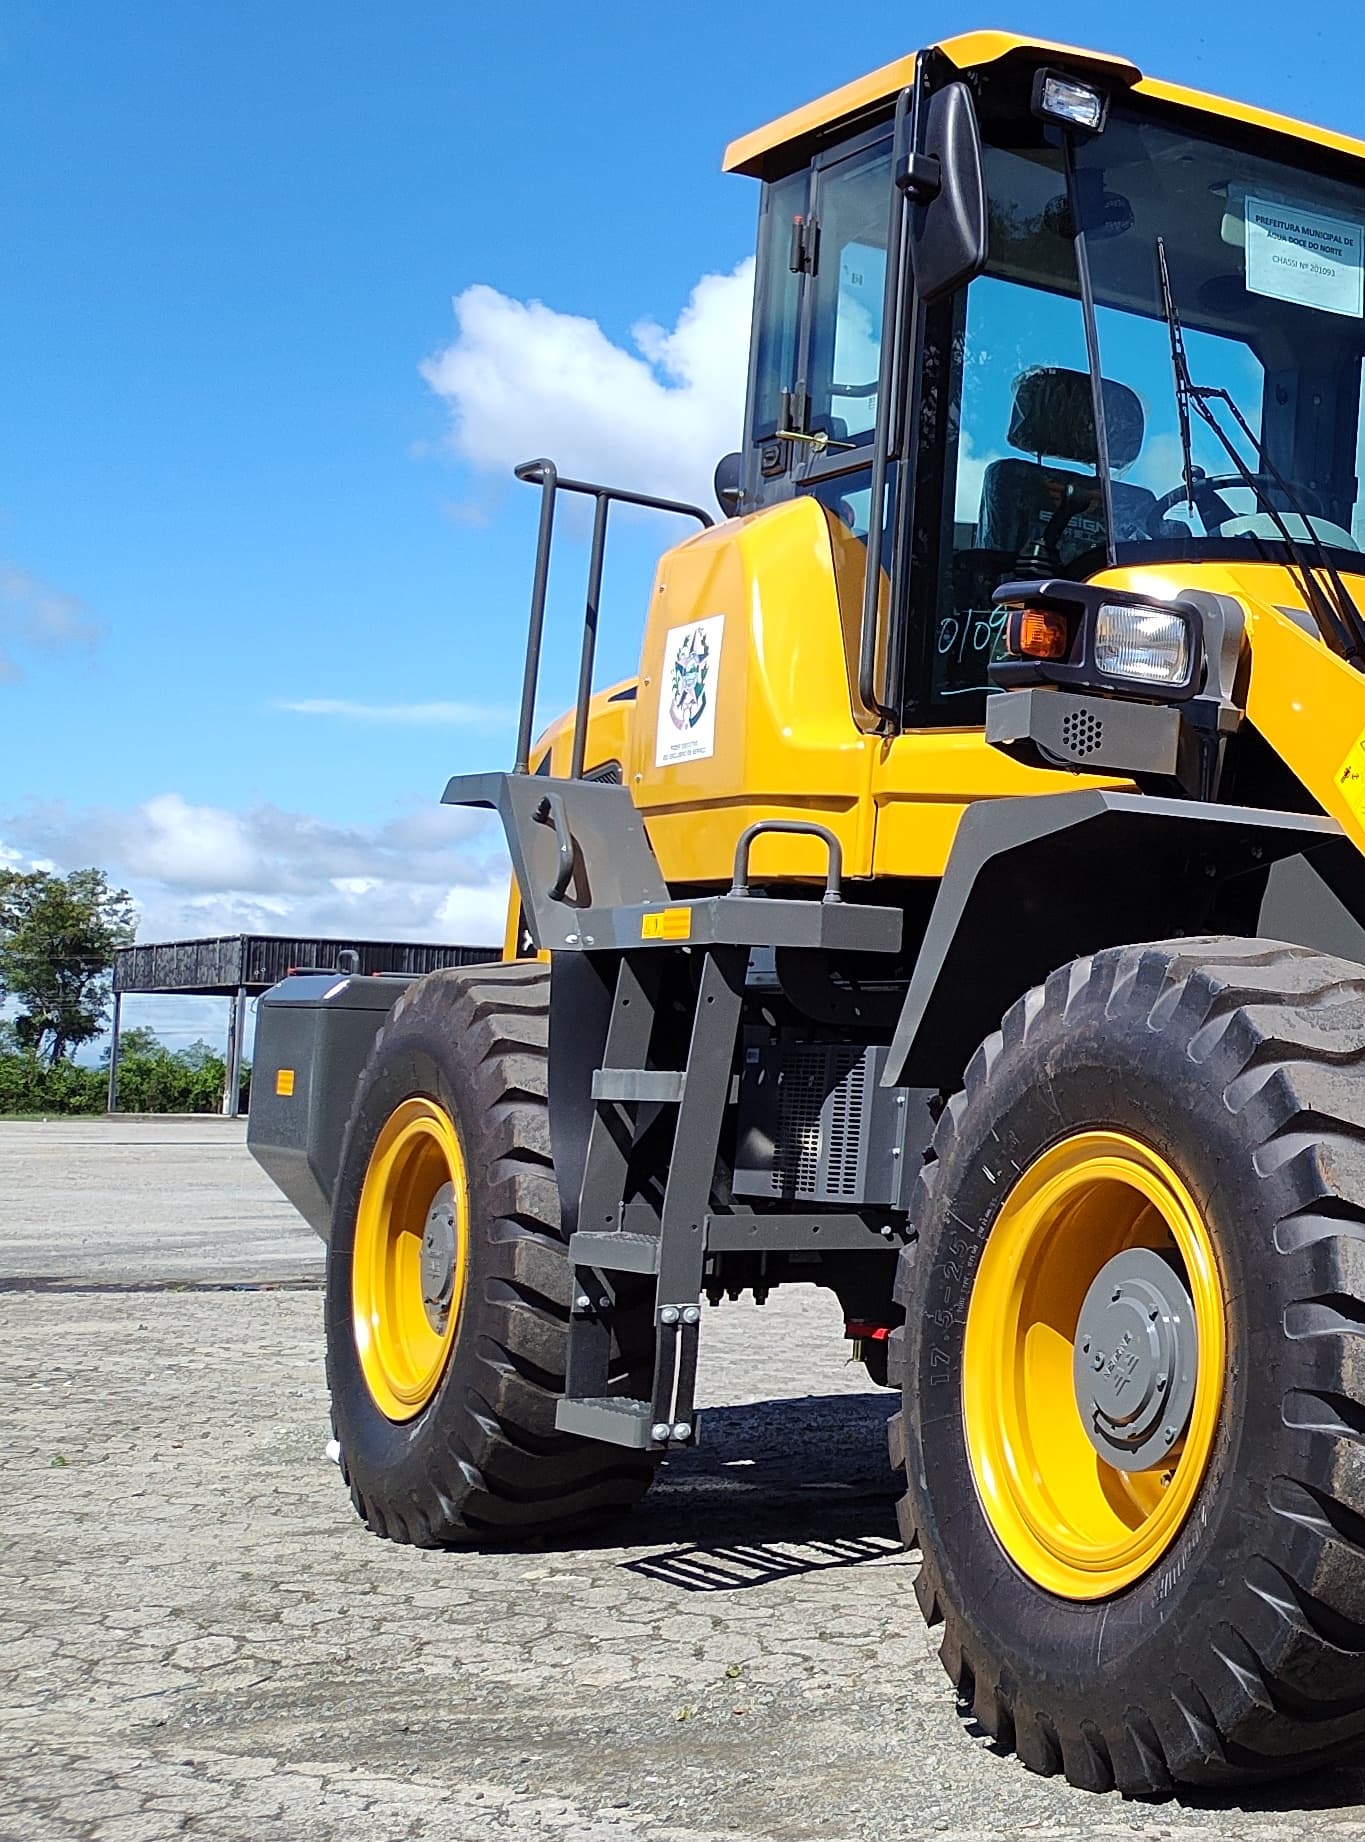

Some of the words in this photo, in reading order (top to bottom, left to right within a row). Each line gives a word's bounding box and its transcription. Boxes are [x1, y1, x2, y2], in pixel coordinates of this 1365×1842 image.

[1255, 214, 1300, 233] PREFEITURA
[1301, 226, 1343, 244] MUNICIPAL
[1344, 237, 1354, 247] DE
[1288, 236, 1307, 248] DOCE
[1308, 241, 1319, 250] DO
[1319, 244, 1343, 257] NORTE
[1272, 255, 1298, 268] CHASSI
[1039, 510, 1106, 533] ESIGN
